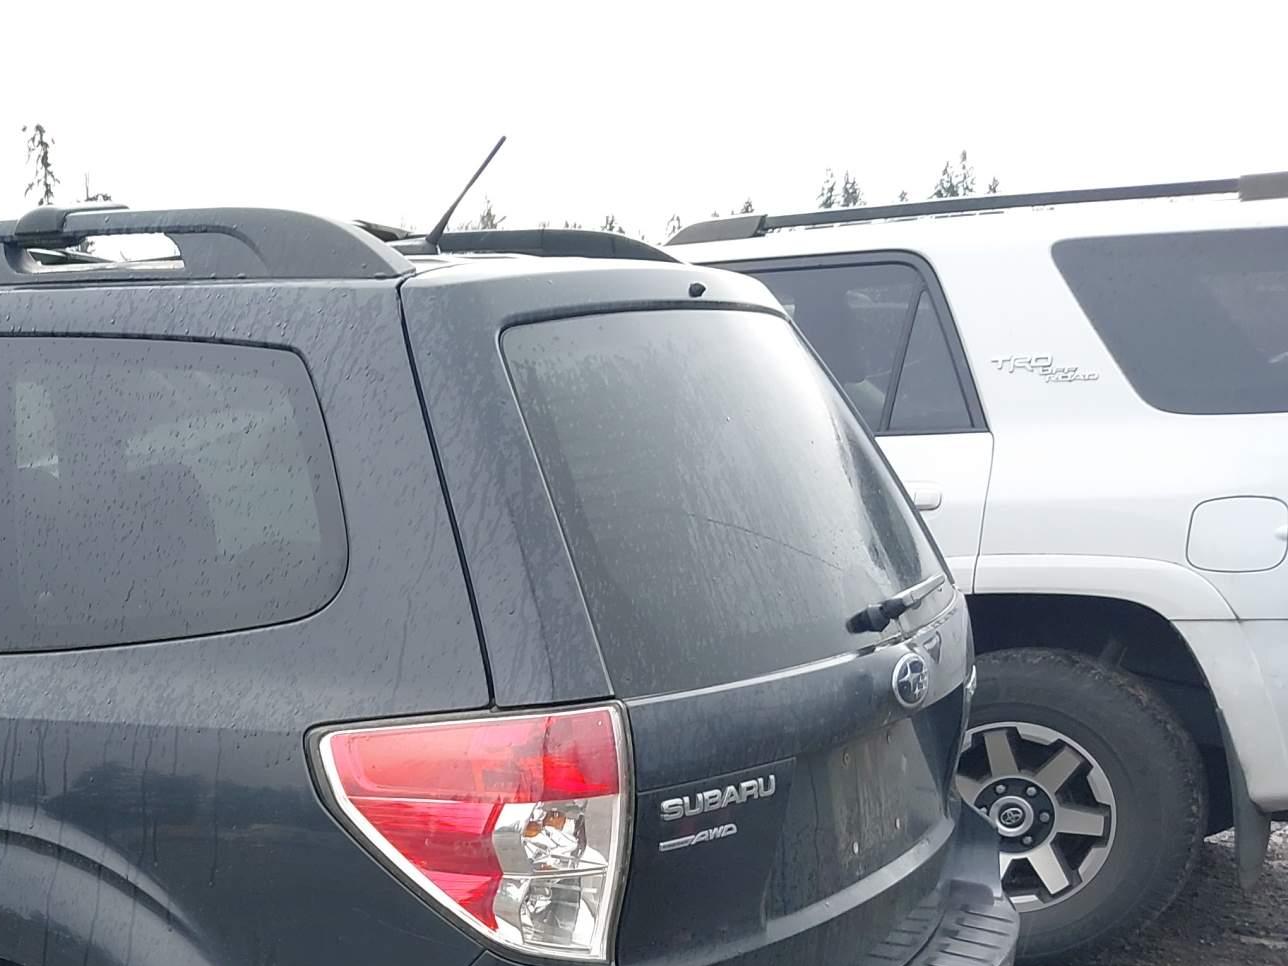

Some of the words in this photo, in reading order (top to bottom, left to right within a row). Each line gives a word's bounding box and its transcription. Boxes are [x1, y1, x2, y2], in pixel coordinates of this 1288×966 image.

[991, 354, 1053, 374] TRD
[660, 774, 776, 821] SUBARU
[691, 823, 737, 845] AWD
